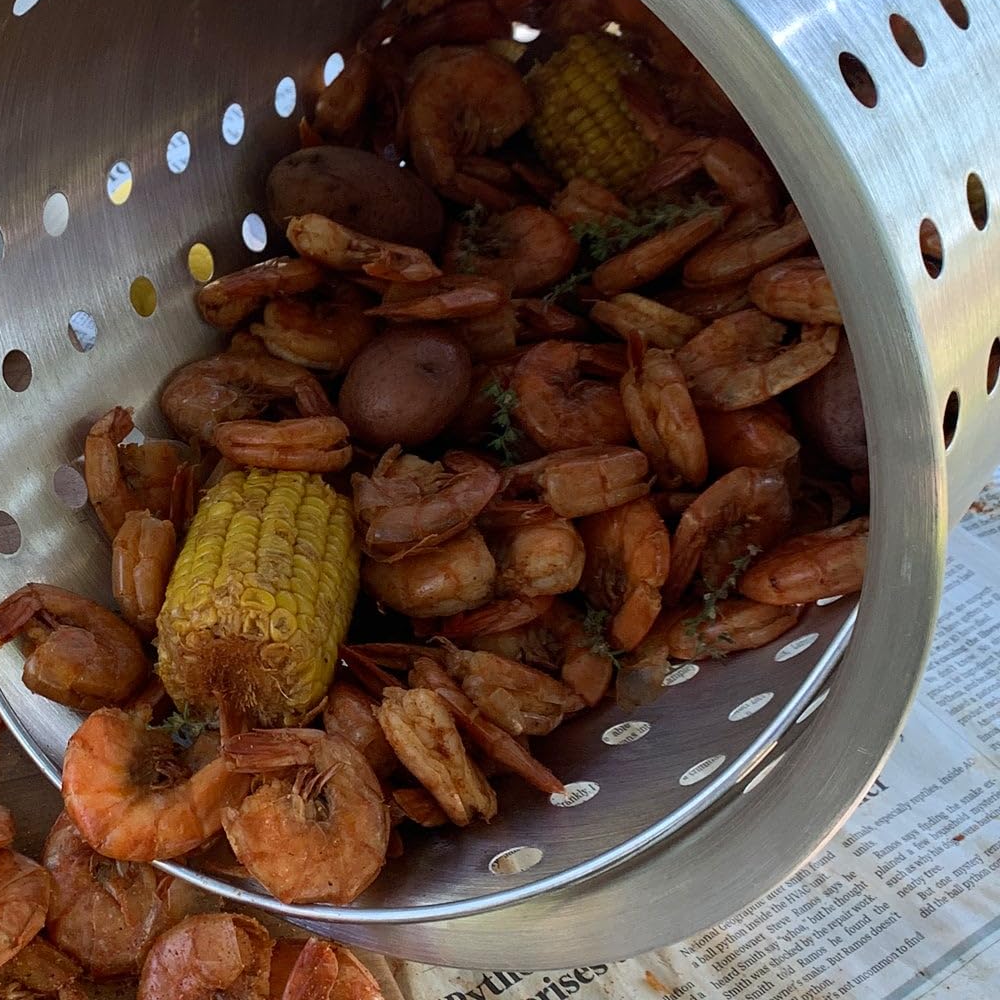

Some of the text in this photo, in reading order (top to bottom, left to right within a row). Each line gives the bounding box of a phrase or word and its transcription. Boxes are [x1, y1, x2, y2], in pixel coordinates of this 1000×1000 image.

[841, 826, 877, 848] animals,
[874, 801, 912, 826] especially
[910, 784, 943, 804] reptiles,
[937, 766, 964, 785] inside
[872, 840, 902, 859] Ramos
[917, 811, 948, 831] finding
[945, 803, 961, 813] the
[959, 787, 983, 804] snake
[874, 852, 906, 879] plained
[912, 838, 930, 850] few
[929, 812, 970, 840] household
[885, 870, 907, 888] such
[905, 864, 916, 873] as
[913, 853, 933, 867] why
[928, 846, 944, 857] his
[896, 865, 944, 898] nearby tree.
[917, 887, 935, 900] But
[935, 876, 952, 889] one
[952, 853, 984, 877] mystery
[679, 928, 719, 957] National
[808, 850, 836, 871] found
[696, 947, 717, 963] ball
[715, 928, 747, 953] python
[745, 911, 772, 931] inside
[770, 901, 787, 913] the
[784, 884, 811, 904] HVAC
[711, 871, 857, 972] Homeowner Steve Ramos says he
[919, 903, 936, 918] did
[933, 896, 949, 907] the
[945, 884, 964, 899] ball
[962, 869, 991, 891] python
[710, 966, 740, 989] heard
[737, 950, 766, 971] Smith
[764, 941, 780, 952] say
[806, 910, 826, 924] but
[822, 904, 836, 915] he
[833, 880, 868, 907] thought
[725, 894, 877, 1000] Smith was shocked by the repair work.
[746, 980, 775, 1000] Smith
[796, 946, 827, 968] Ramos
[828, 936, 843, 947] he
[844, 913, 872, 936] found
[872, 902, 890, 915] the
[801, 964, 830, 981] snake.
[826, 952, 845, 966] But
[840, 934, 872, 956] Ramos
[870, 911, 902, 936] doesn't
[838, 980, 855, 995] not
[853, 952, 899, 984] uncommon
[895, 945, 908, 954] to
[903, 930, 925, 948] find
